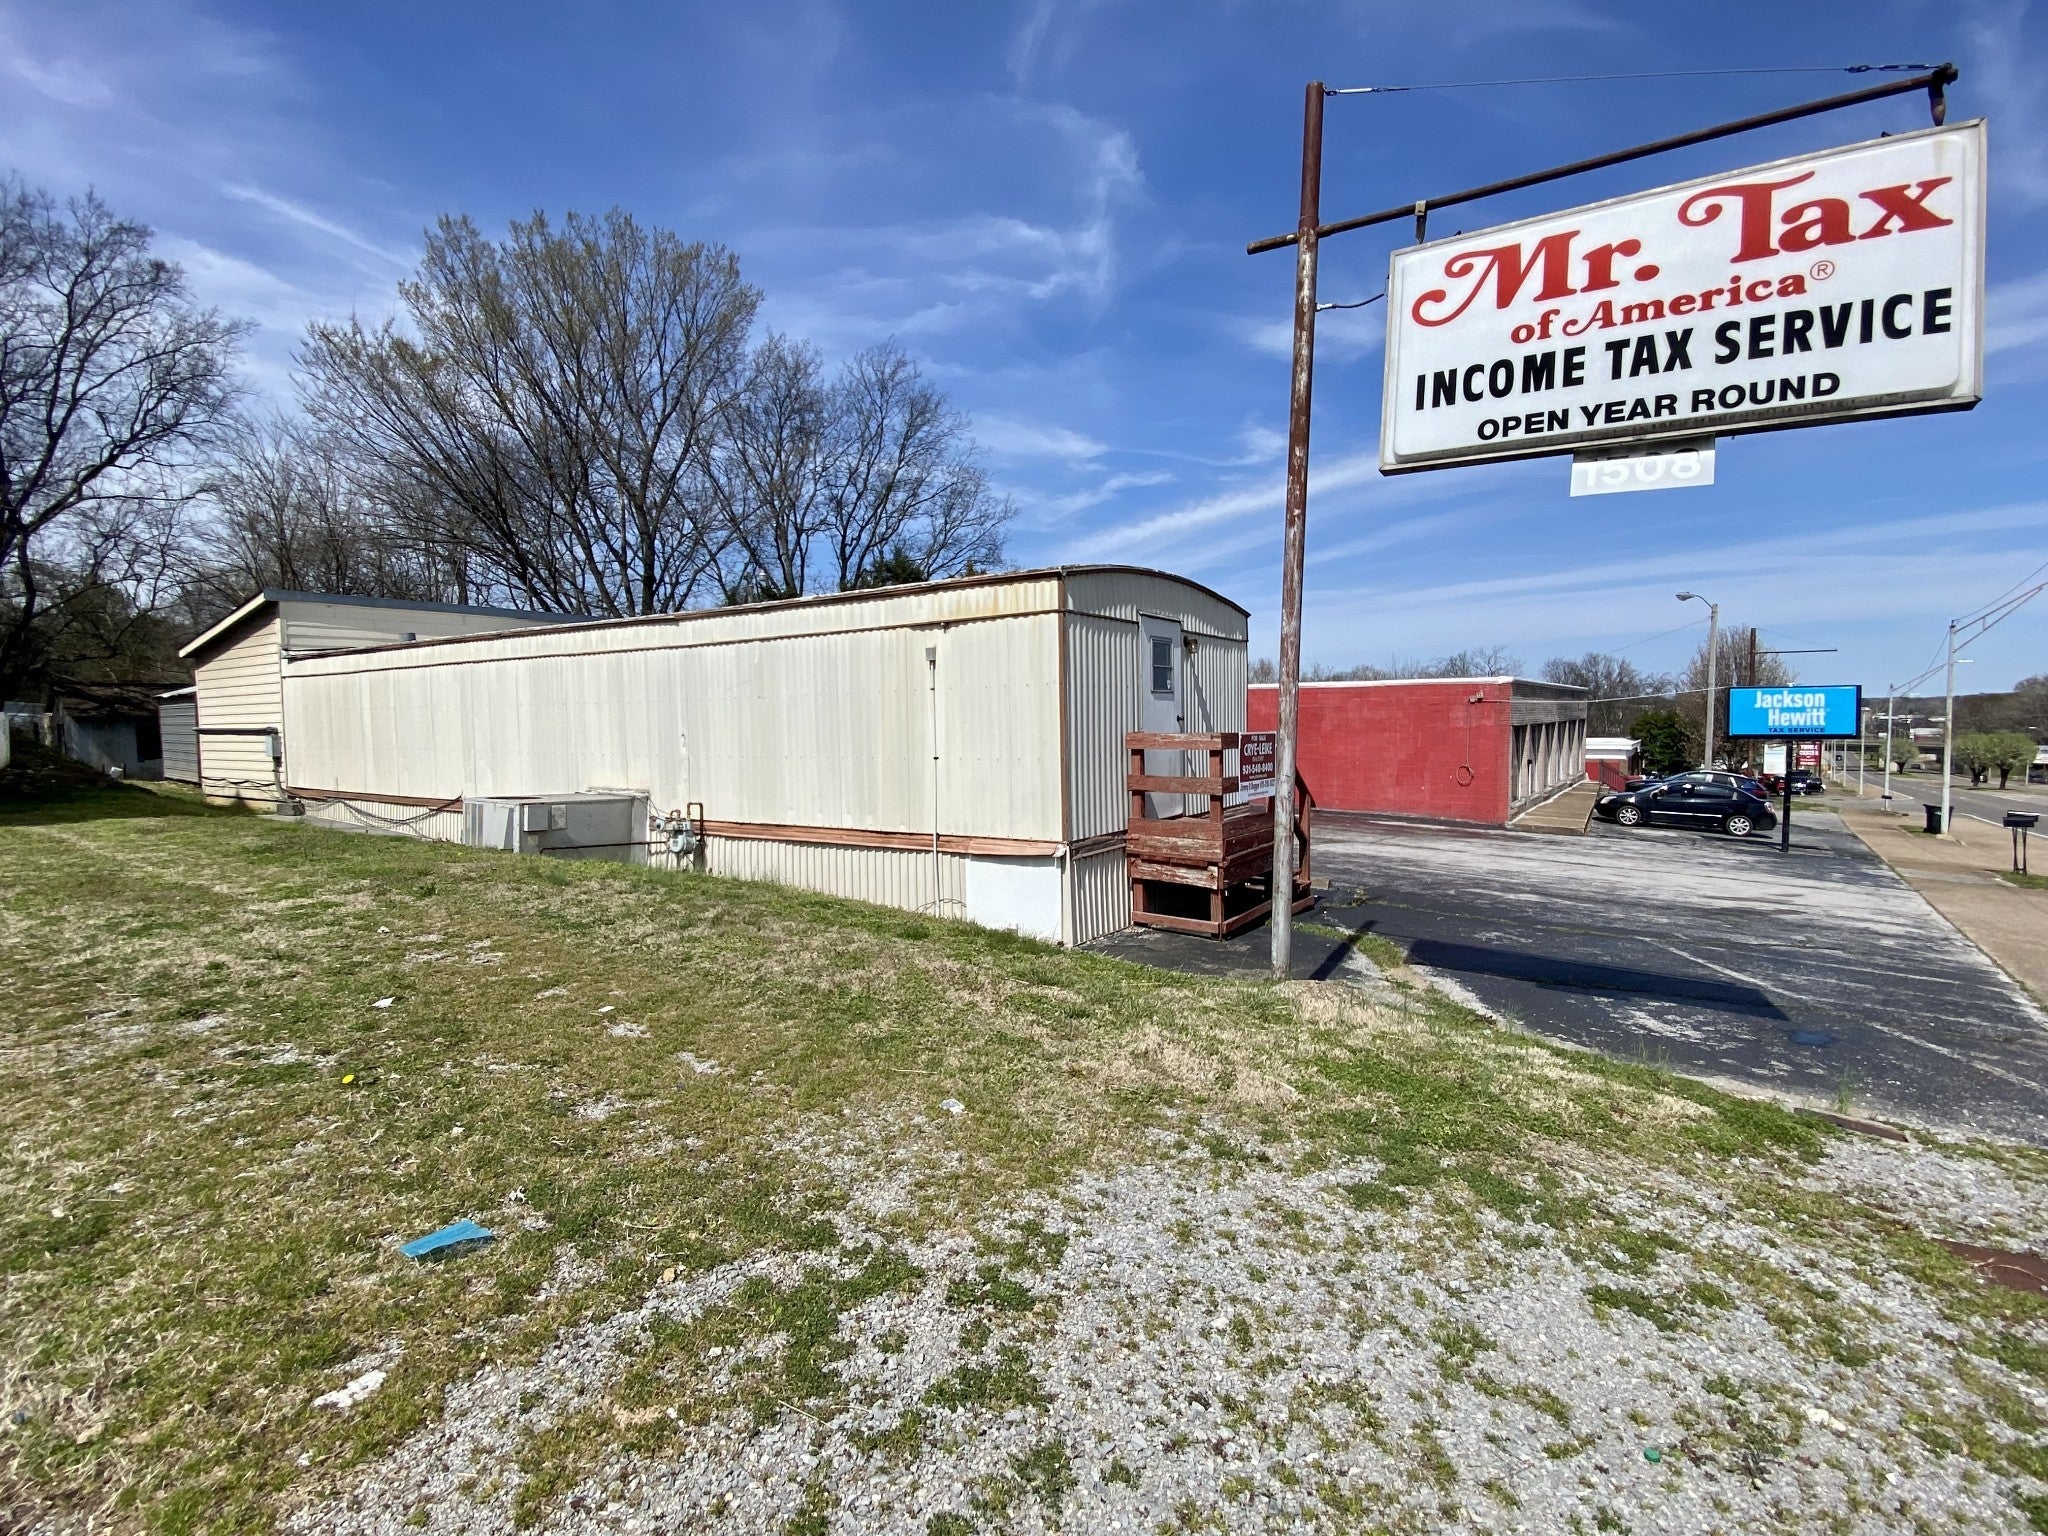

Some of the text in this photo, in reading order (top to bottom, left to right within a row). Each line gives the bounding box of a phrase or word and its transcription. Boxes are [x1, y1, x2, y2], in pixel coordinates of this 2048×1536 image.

[1412, 170, 1954, 327] Mr. Tax
[1510, 308, 1561, 344] of
[1415, 287, 1952, 411] INCOME TAX SERVICE
[1477, 372, 1840, 441] OPEN YEAR ROUND
[1581, 448, 1701, 488] 1508
[1754, 691, 1825, 708] Jackson
[1768, 708, 1826, 726] Hewitt
